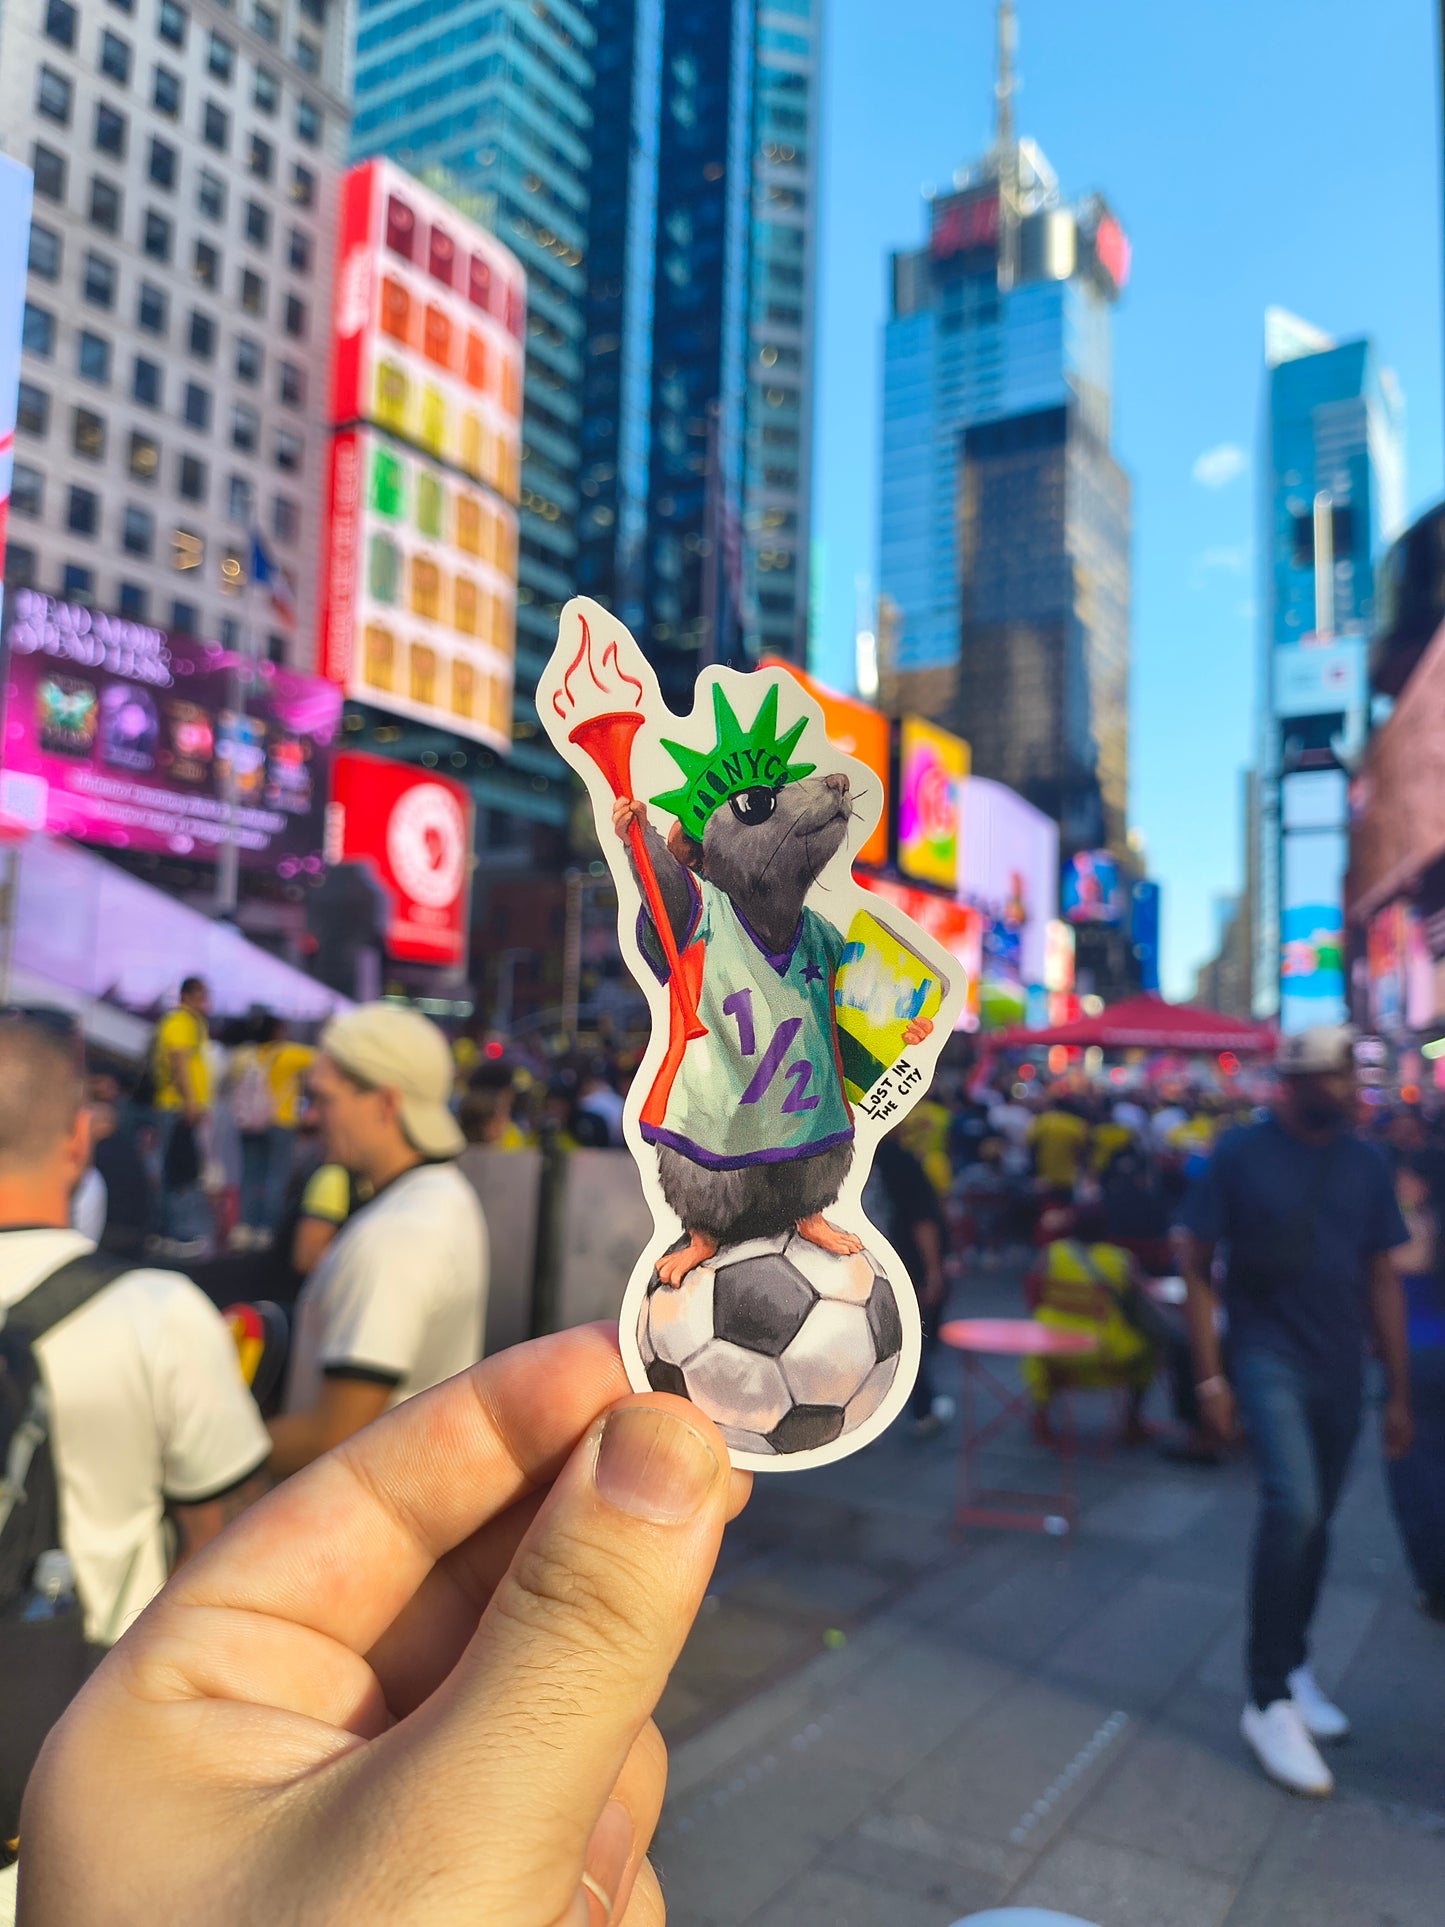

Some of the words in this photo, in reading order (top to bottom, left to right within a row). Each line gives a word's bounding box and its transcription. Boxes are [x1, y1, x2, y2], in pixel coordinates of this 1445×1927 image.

[721, 748, 782, 786] NYC
[723, 987, 821, 1113] 1/2
[858, 1077, 893, 1115] LOST
[892, 1059, 911, 1077] IN
[871, 1100, 899, 1120] THE
[898, 1067, 922, 1095] CITY
